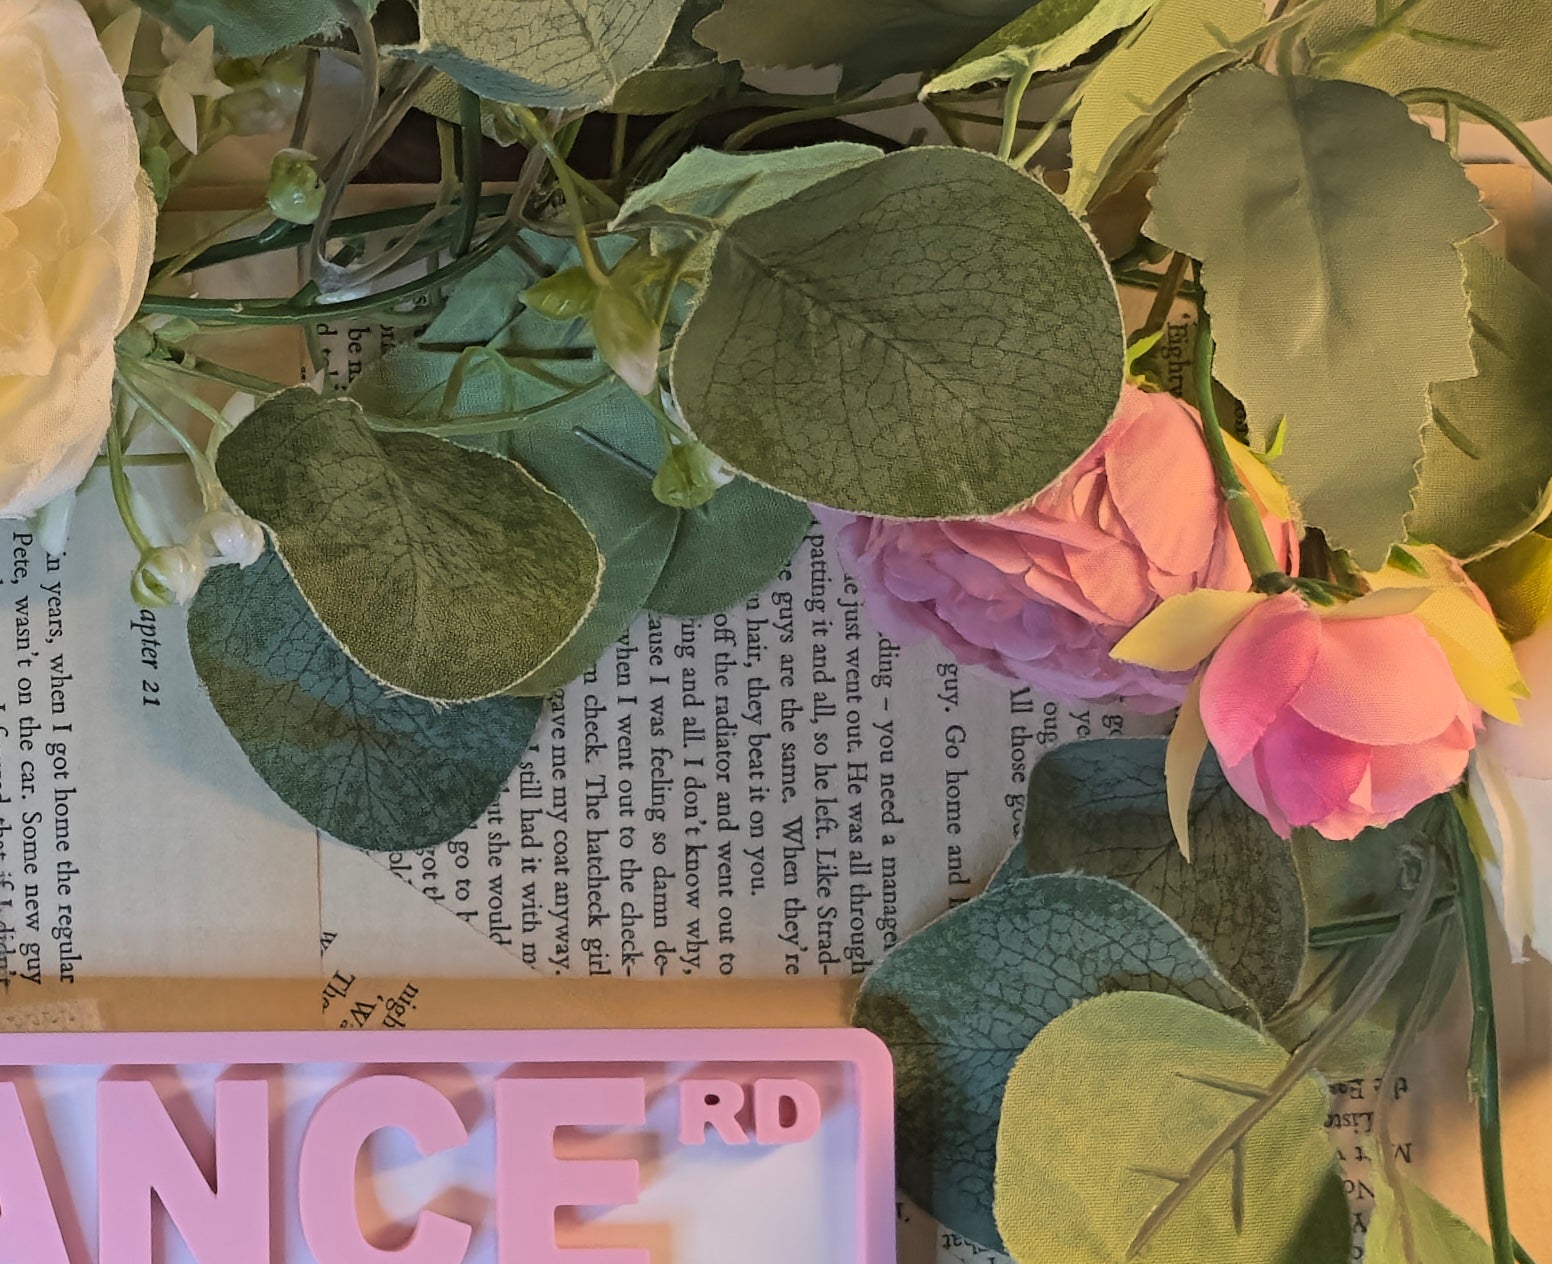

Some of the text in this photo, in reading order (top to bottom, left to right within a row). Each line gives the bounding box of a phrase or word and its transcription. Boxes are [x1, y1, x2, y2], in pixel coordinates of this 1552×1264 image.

[10, 532, 43, 986] Pete, wasn't on the car. Some new guy
[38, 579, 84, 985] years, when I got home the regular
[128, 607, 163, 707] apter 21
[739, 617, 773, 897] hair, they beat it on you.
[935, 661, 972, 887] guy. Go home and
[579, 693, 613, 978] check. The hatcheck girl
[713, 651, 741, 977] the radiator and went out to
[678, 1077, 822, 1146] RD
